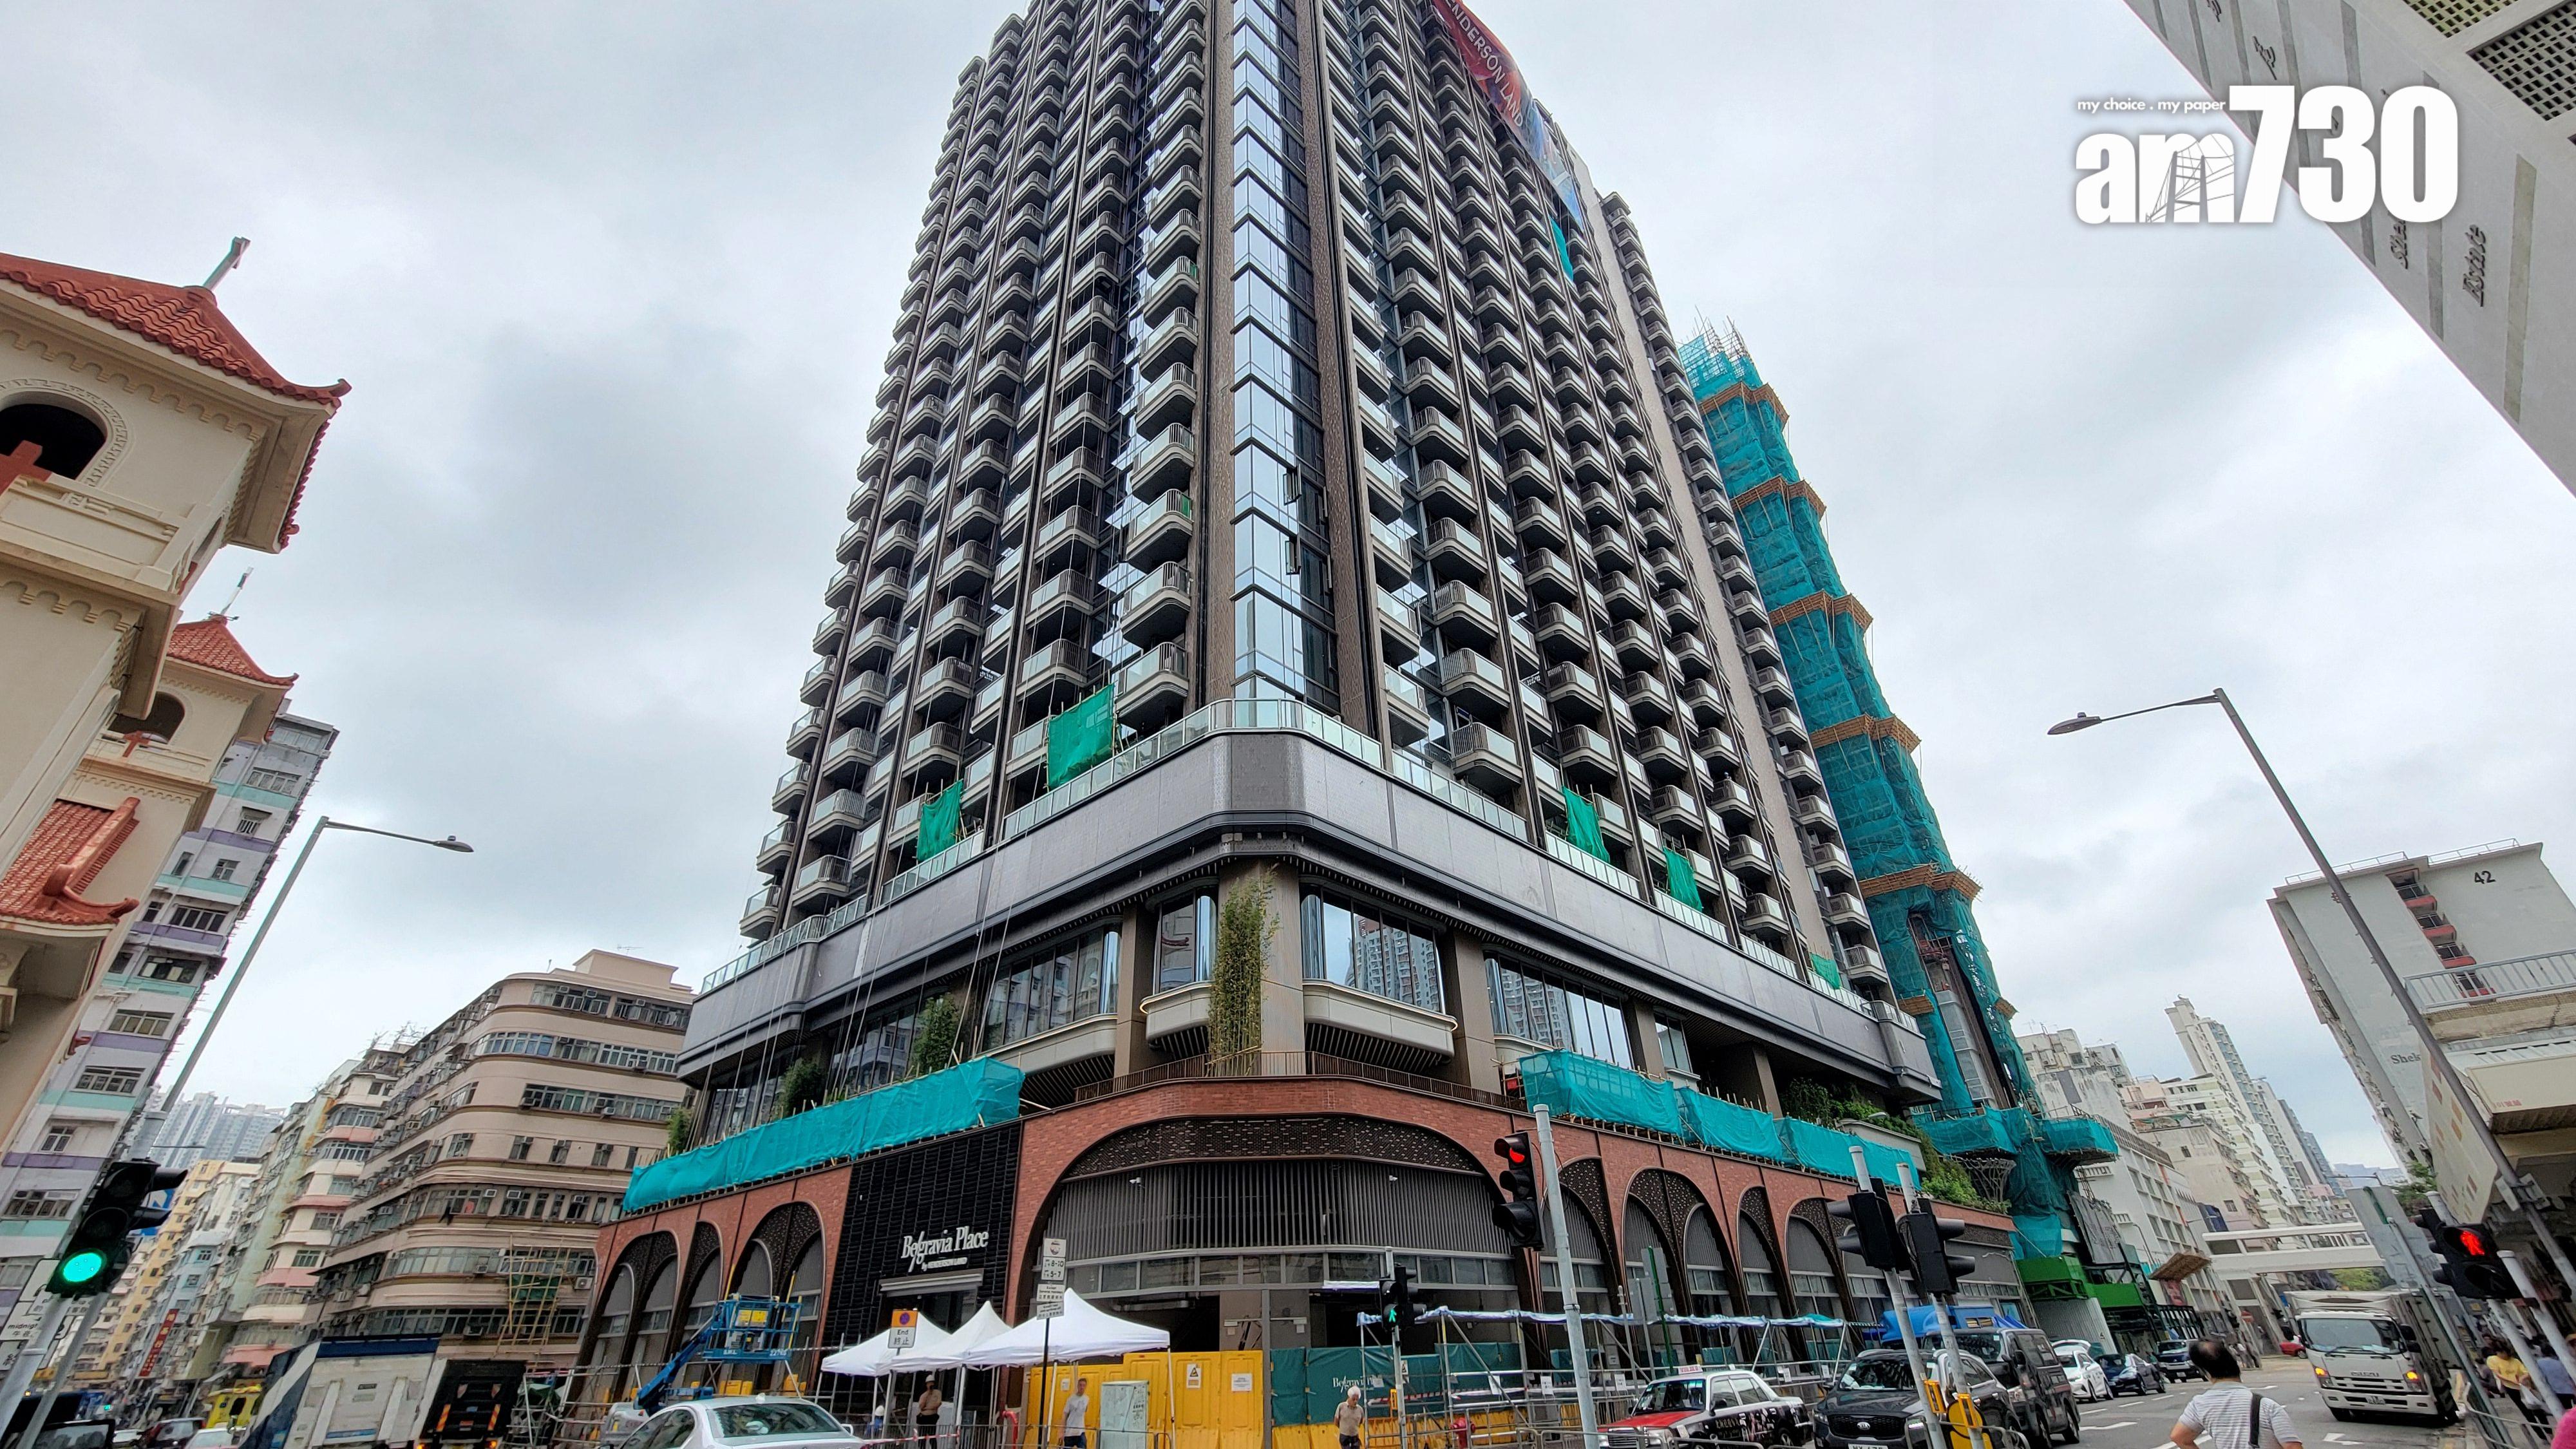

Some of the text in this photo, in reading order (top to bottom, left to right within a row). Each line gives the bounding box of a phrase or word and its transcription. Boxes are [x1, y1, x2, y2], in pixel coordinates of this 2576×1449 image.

[1501, 82, 1523, 127] LAND
[2462, 224, 2486, 307] Estate
[2474, 870, 2496, 884] 42
[2390, 1052, 2421, 1065] Shek
[900, 1226, 989, 1273] Belgravia Place
[1332, 1376, 1367, 1393] Belgravi
